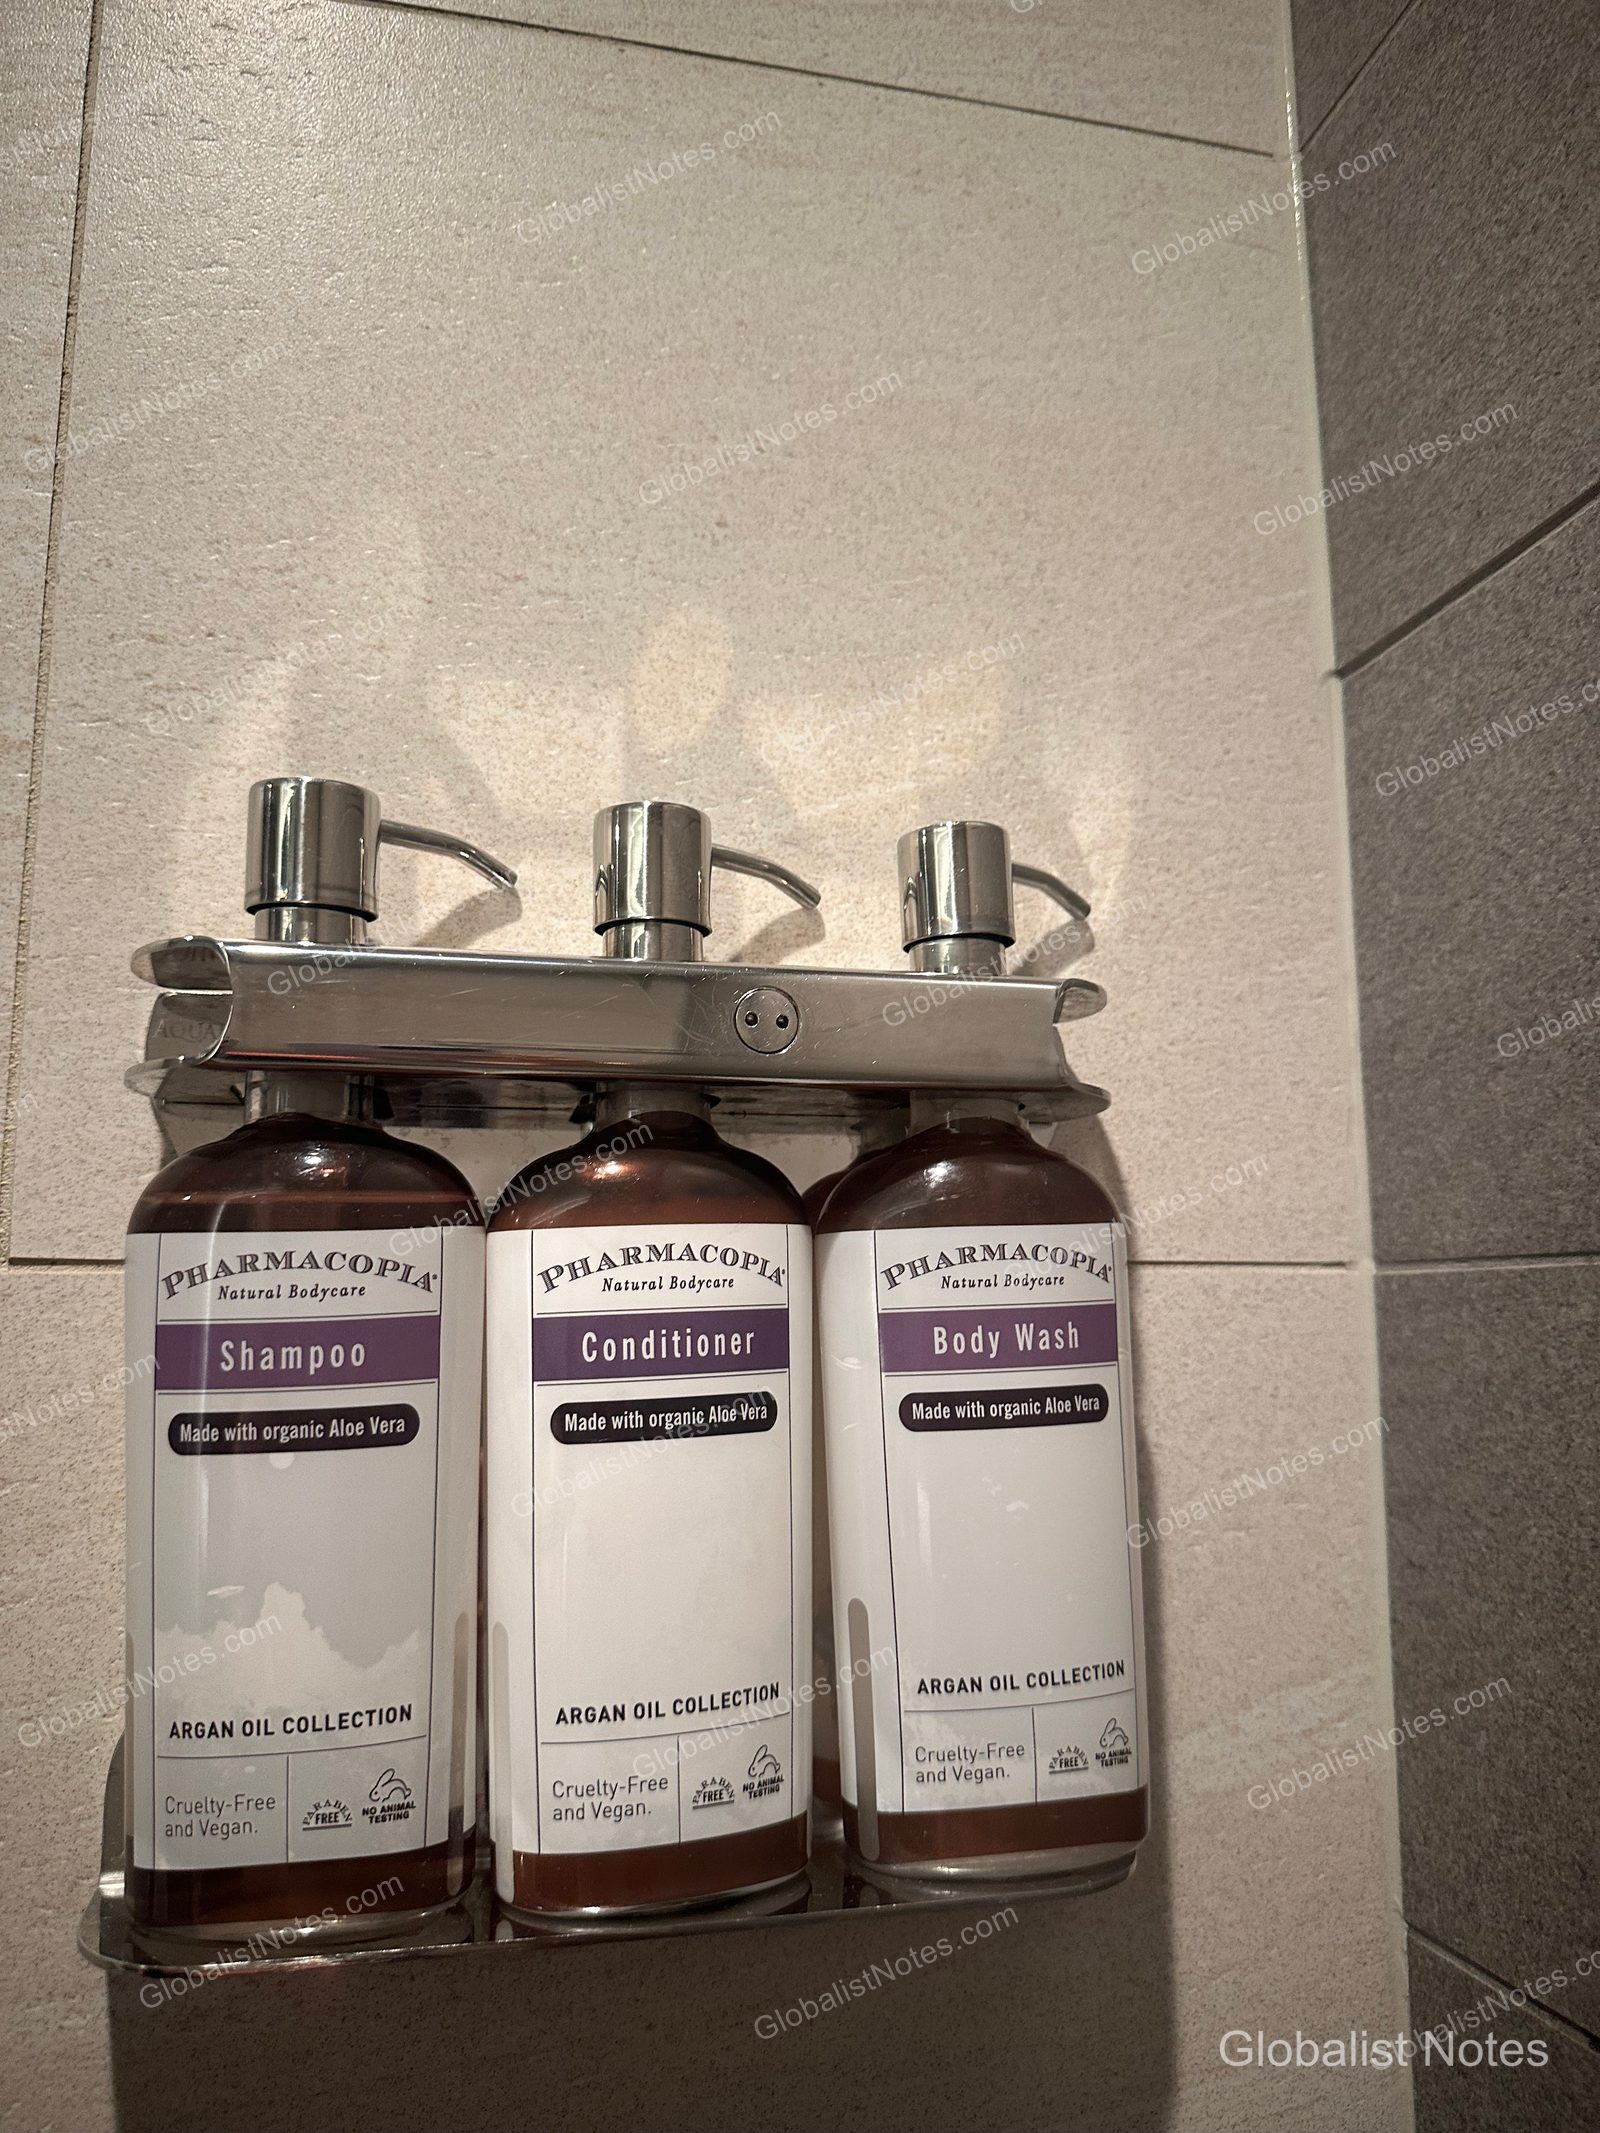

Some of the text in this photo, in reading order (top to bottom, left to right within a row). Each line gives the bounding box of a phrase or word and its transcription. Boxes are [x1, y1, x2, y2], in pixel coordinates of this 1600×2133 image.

[218, 1285, 366, 1302] Natural Bodycare
[602, 1276, 735, 1294] Natural Bodycare
[941, 1274, 1065, 1291] Natural Bodycare
[582, 1328, 755, 1363] Conditioner
[933, 1321, 1080, 1358] Body Wash
[220, 1340, 366, 1375] Shampoo
[565, 1403, 768, 1433] Made with organic Aloe Vera
[911, 1394, 1100, 1421] Made with organic Aloe Vera
[180, 1415, 406, 1444] Made with organic Aloe Vera
[917, 1659, 1125, 1695] ARGAN OIL COLLECTION
[555, 1682, 780, 1725] ARGAN OIL COLLECTION
[169, 1703, 413, 1740] ARGAN OIL COLLECTION
[915, 1742, 1025, 1764] Cruelty-Free
[1059, 1756, 1079, 1769] FREE
[742, 1774, 784, 1793] NO ANIMAL
[916, 1764, 1010, 1785] and Vegan.
[552, 1775, 669, 1801] Cruelty-Free
[703, 1790, 724, 1803] FREE
[165, 1793, 276, 1818] Cruelty-Free
[362, 1801, 416, 1817] NO ANIMAL
[368, 1811, 410, 1824] TESTING
[552, 1799, 652, 1823] and Vegan.
[164, 1817, 258, 1841] and Vegan.
[315, 1811, 340, 1825] FREE
